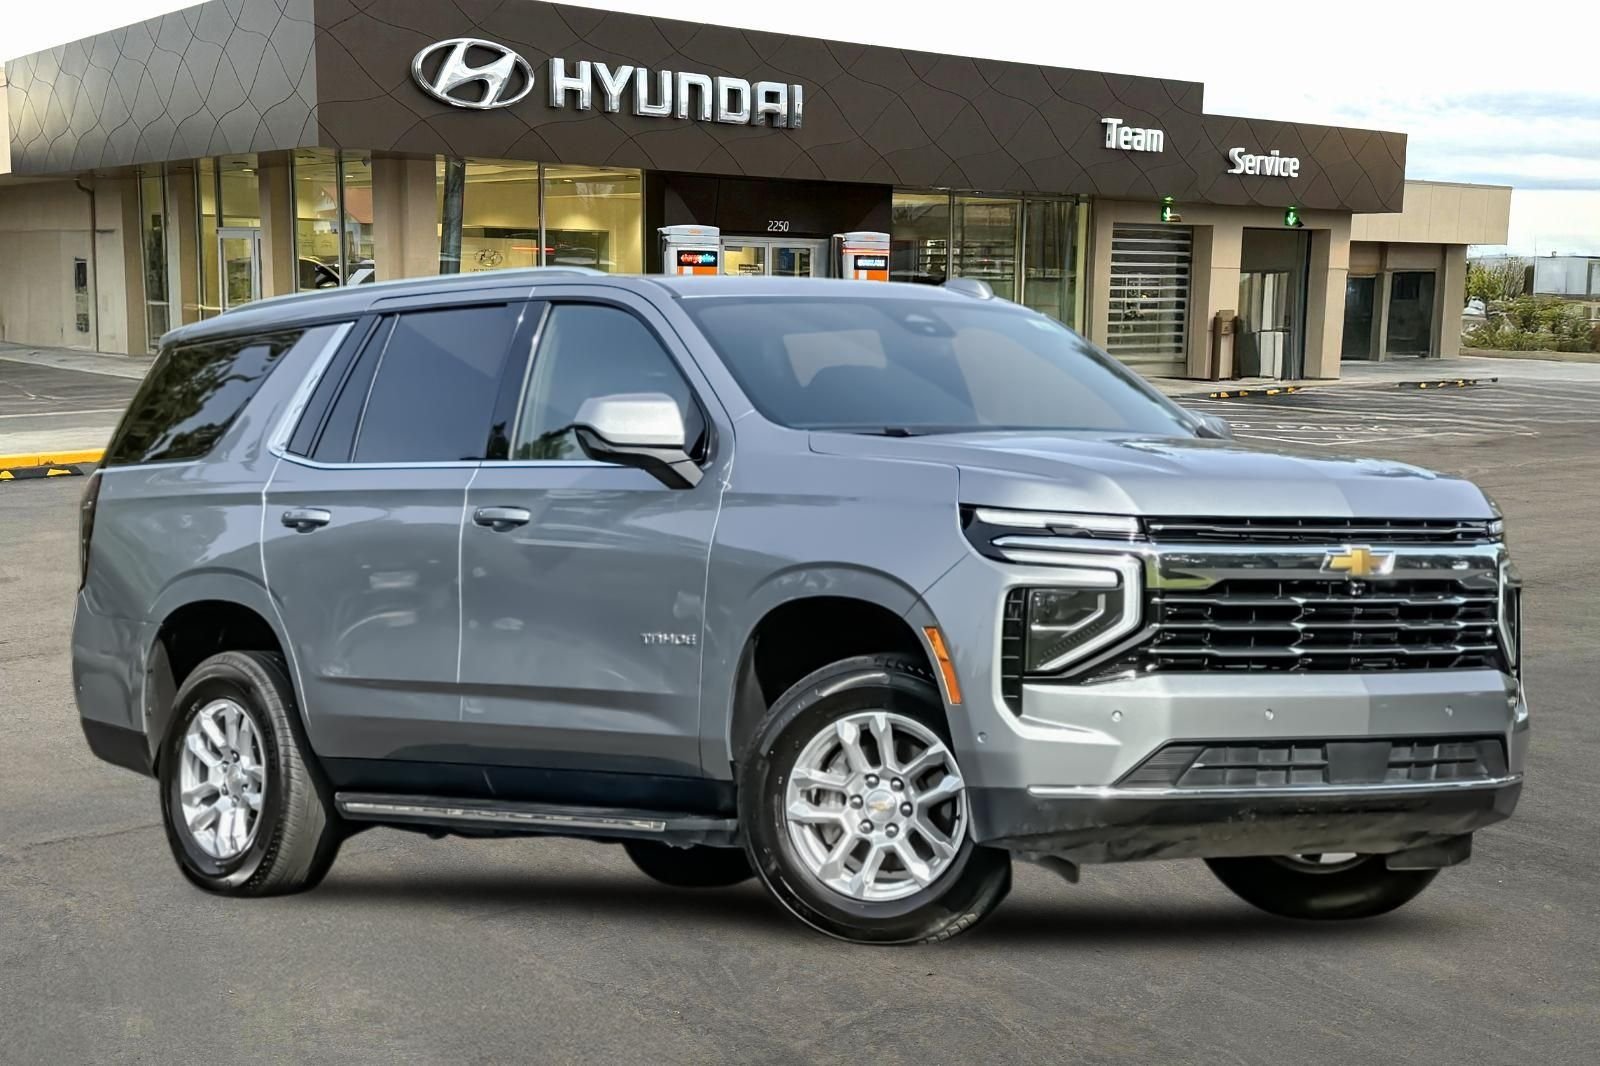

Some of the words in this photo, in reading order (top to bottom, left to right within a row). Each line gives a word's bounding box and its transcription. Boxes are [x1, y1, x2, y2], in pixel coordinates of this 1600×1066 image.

[549, 57, 803, 128] HYUNDAI
[1101, 117, 1164, 153] Team
[1227, 147, 1300, 178] Service
[767, 220, 790, 232] 2250
